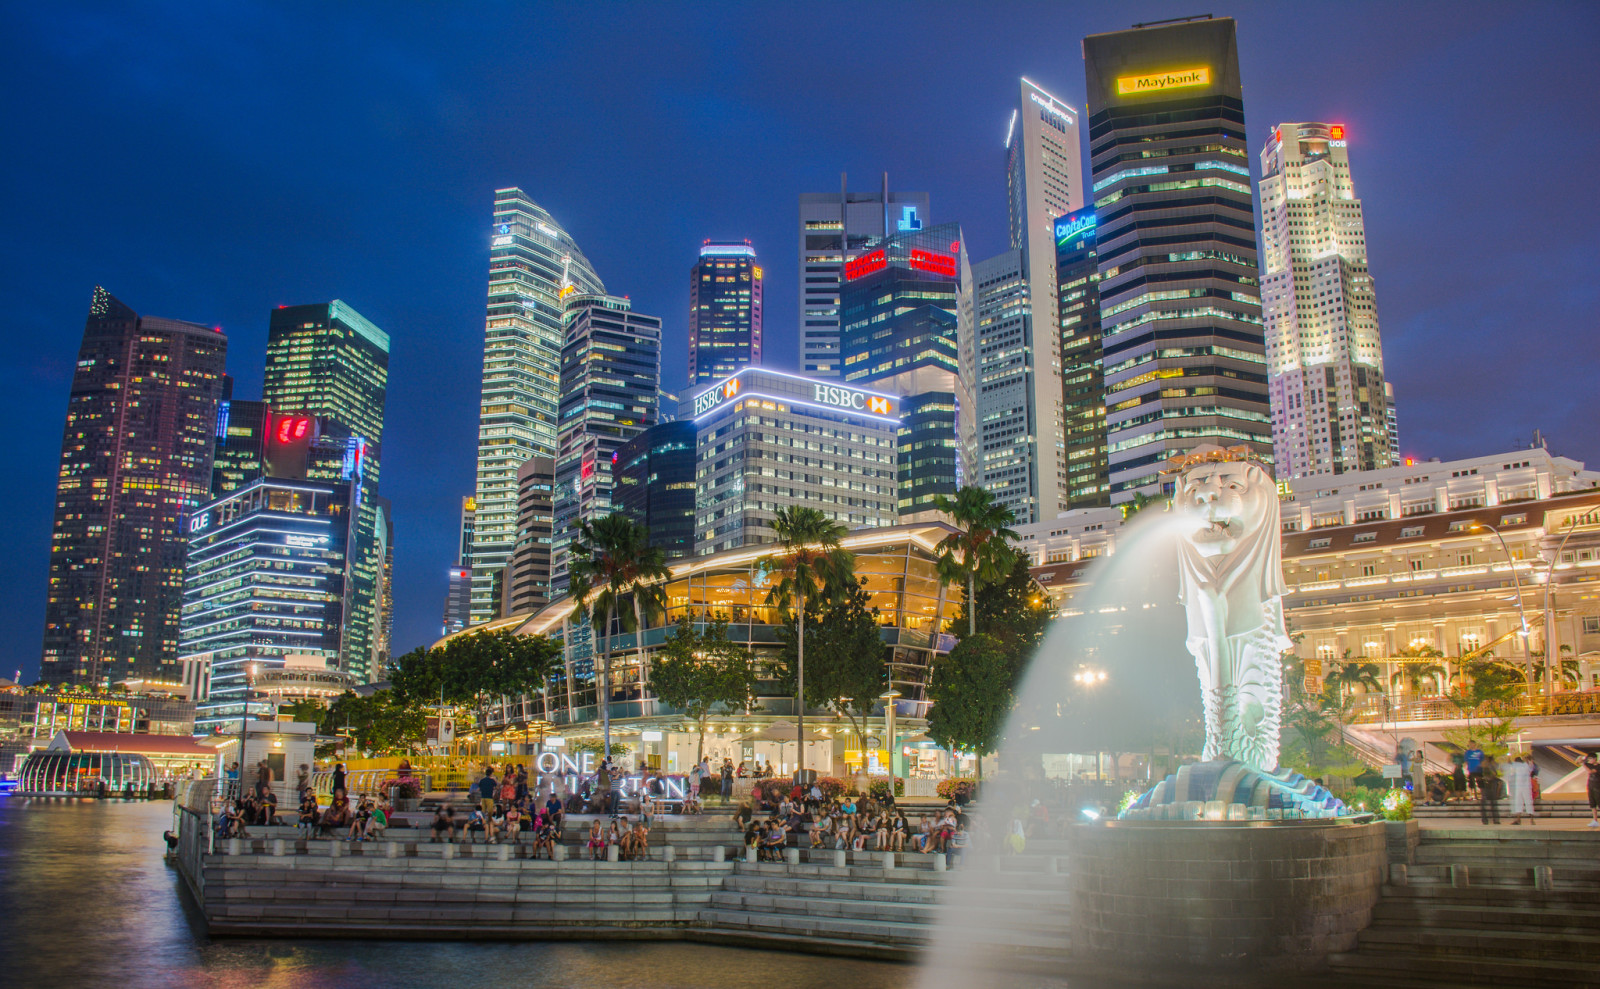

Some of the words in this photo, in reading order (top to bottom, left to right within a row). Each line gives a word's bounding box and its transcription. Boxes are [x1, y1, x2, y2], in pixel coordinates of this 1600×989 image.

[1137, 72, 1200, 88] Maybank
[1081, 229, 1096, 239] Trust
[845, 249, 884, 272] STRAITS
[909, 258, 956, 276] TRADING
[911, 249, 956, 267] STRAITS
[845, 258, 887, 280] TRADING
[694, 385, 724, 416] HSBC
[814, 383, 865, 410] HSBC
[190, 513, 209, 532] OUE
[68, 697, 99, 705] FULLERTON
[537, 752, 595, 774] ONE
[536, 776, 686, 799] ULRTON
